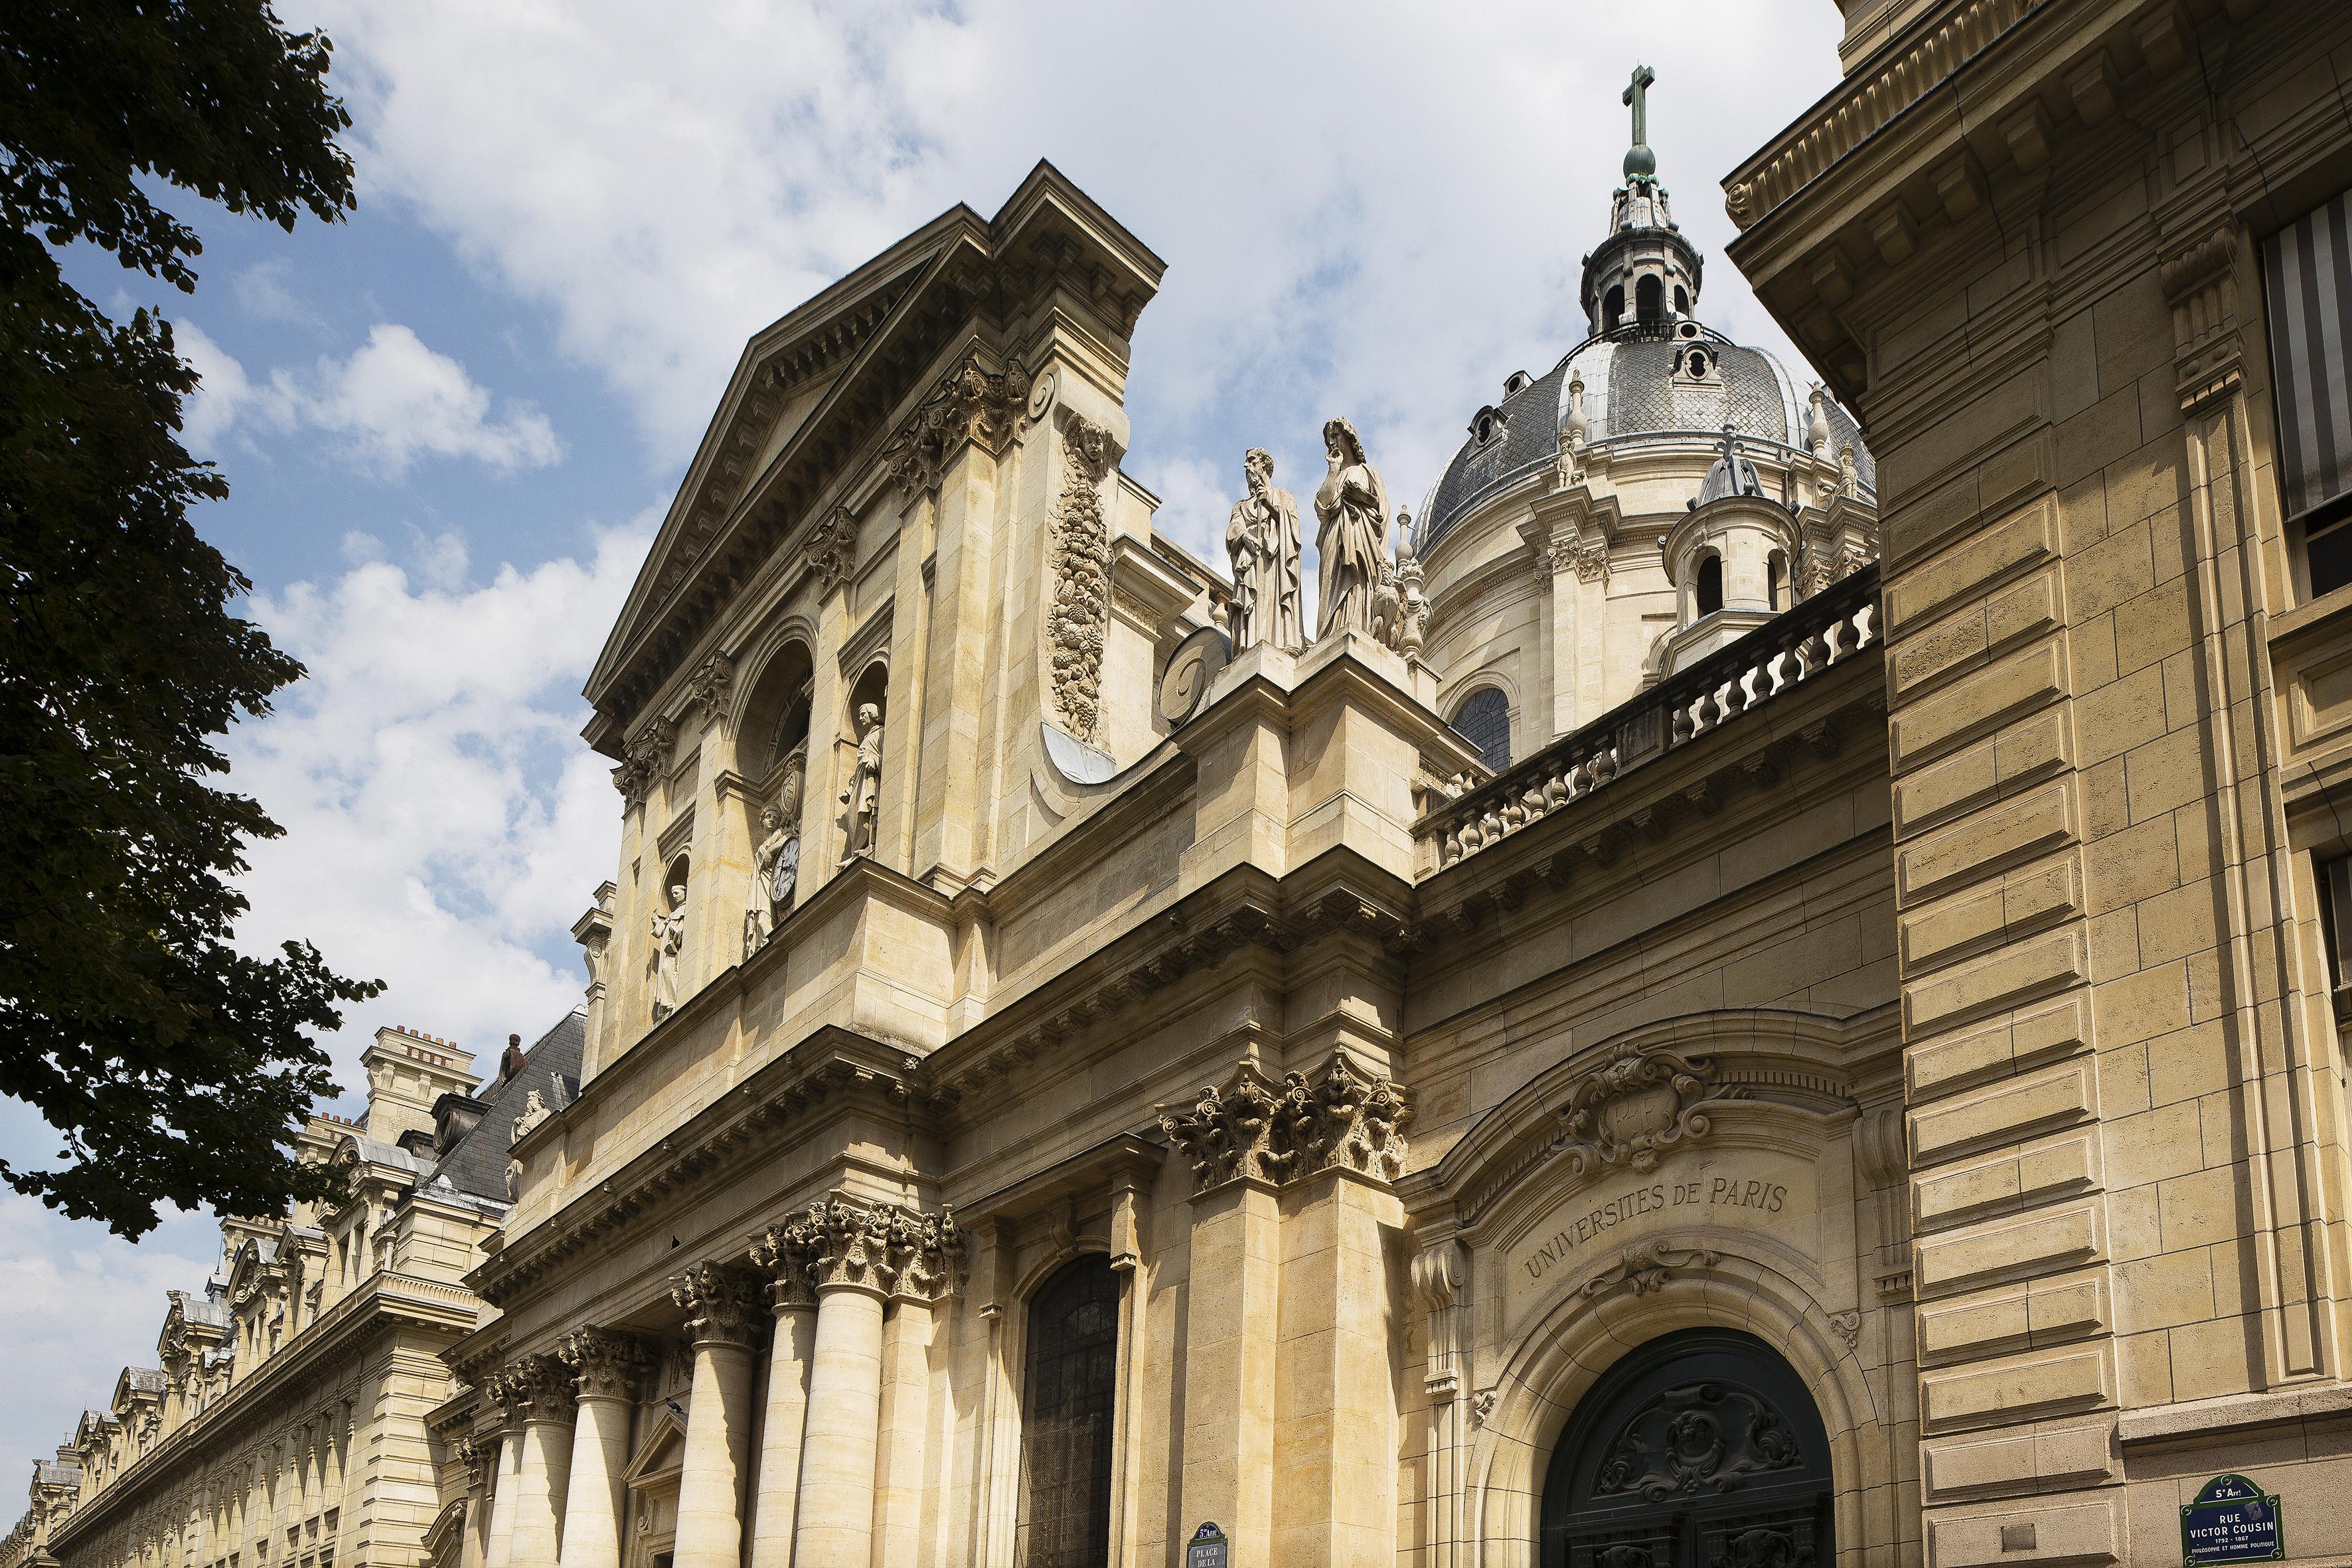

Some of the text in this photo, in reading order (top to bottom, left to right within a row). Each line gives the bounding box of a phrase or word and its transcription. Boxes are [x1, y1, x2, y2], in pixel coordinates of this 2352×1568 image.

[1525, 1177, 1788, 1278] UNIVERSITES DE PARIS
[2219, 1514, 2241, 1524] RUE
[2190, 1522, 2274, 1539] VICTOR COUSIN
[1196, 1547, 1218, 1558] PLACE
[2191, 1545, 2220, 1554] PHILOSOPHE
[1198, 1558, 1215, 1568] DE LA
